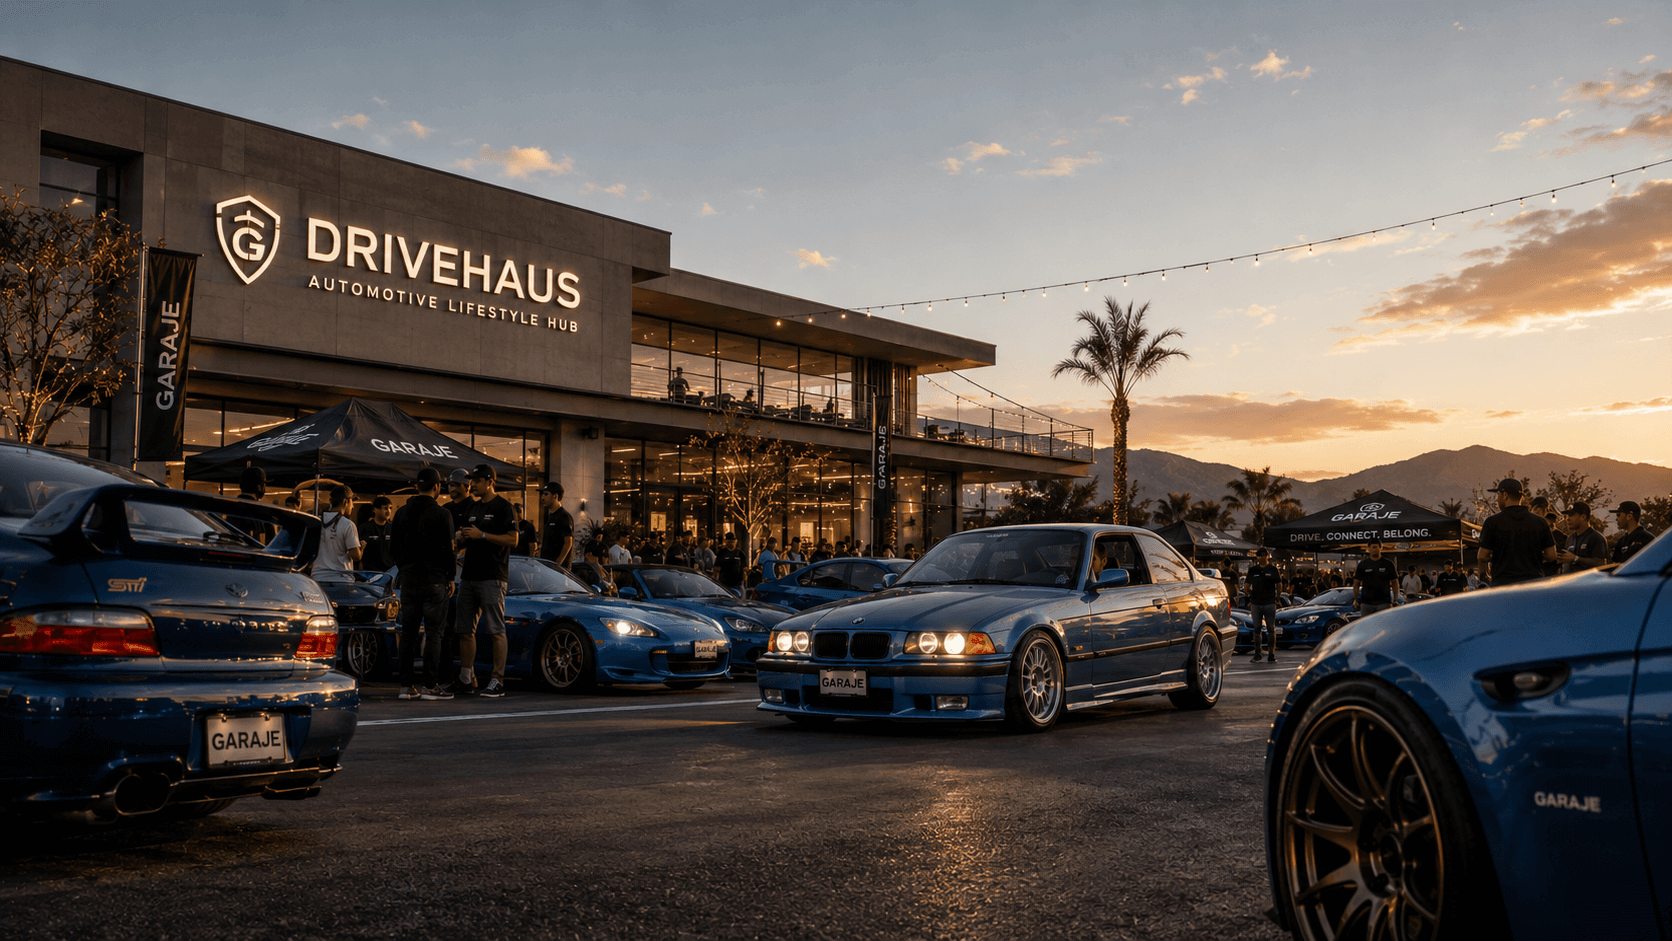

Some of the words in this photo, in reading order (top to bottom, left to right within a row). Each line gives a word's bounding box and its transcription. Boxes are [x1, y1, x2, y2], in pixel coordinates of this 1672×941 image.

[307, 216, 581, 309] DRIVEHAUS
[308, 275, 438, 309] AUTOMOTIVE
[448, 299, 539, 326] LIFESTYLE
[547, 317, 578, 333] HUB
[155, 300, 180, 411] GARAJE
[371, 438, 459, 459] GARAJE
[878, 425, 887, 490] GARAJE
[1331, 511, 1402, 522] GARAJE
[1290, 533, 1325, 542] DRIVE.
[1326, 530, 1380, 541] CONNECT.
[1383, 528, 1432, 539] BELONG.
[821, 677, 864, 689] GARAJE
[211, 730, 281, 751] GARAJE
[1534, 791, 1602, 814] GARAJE
